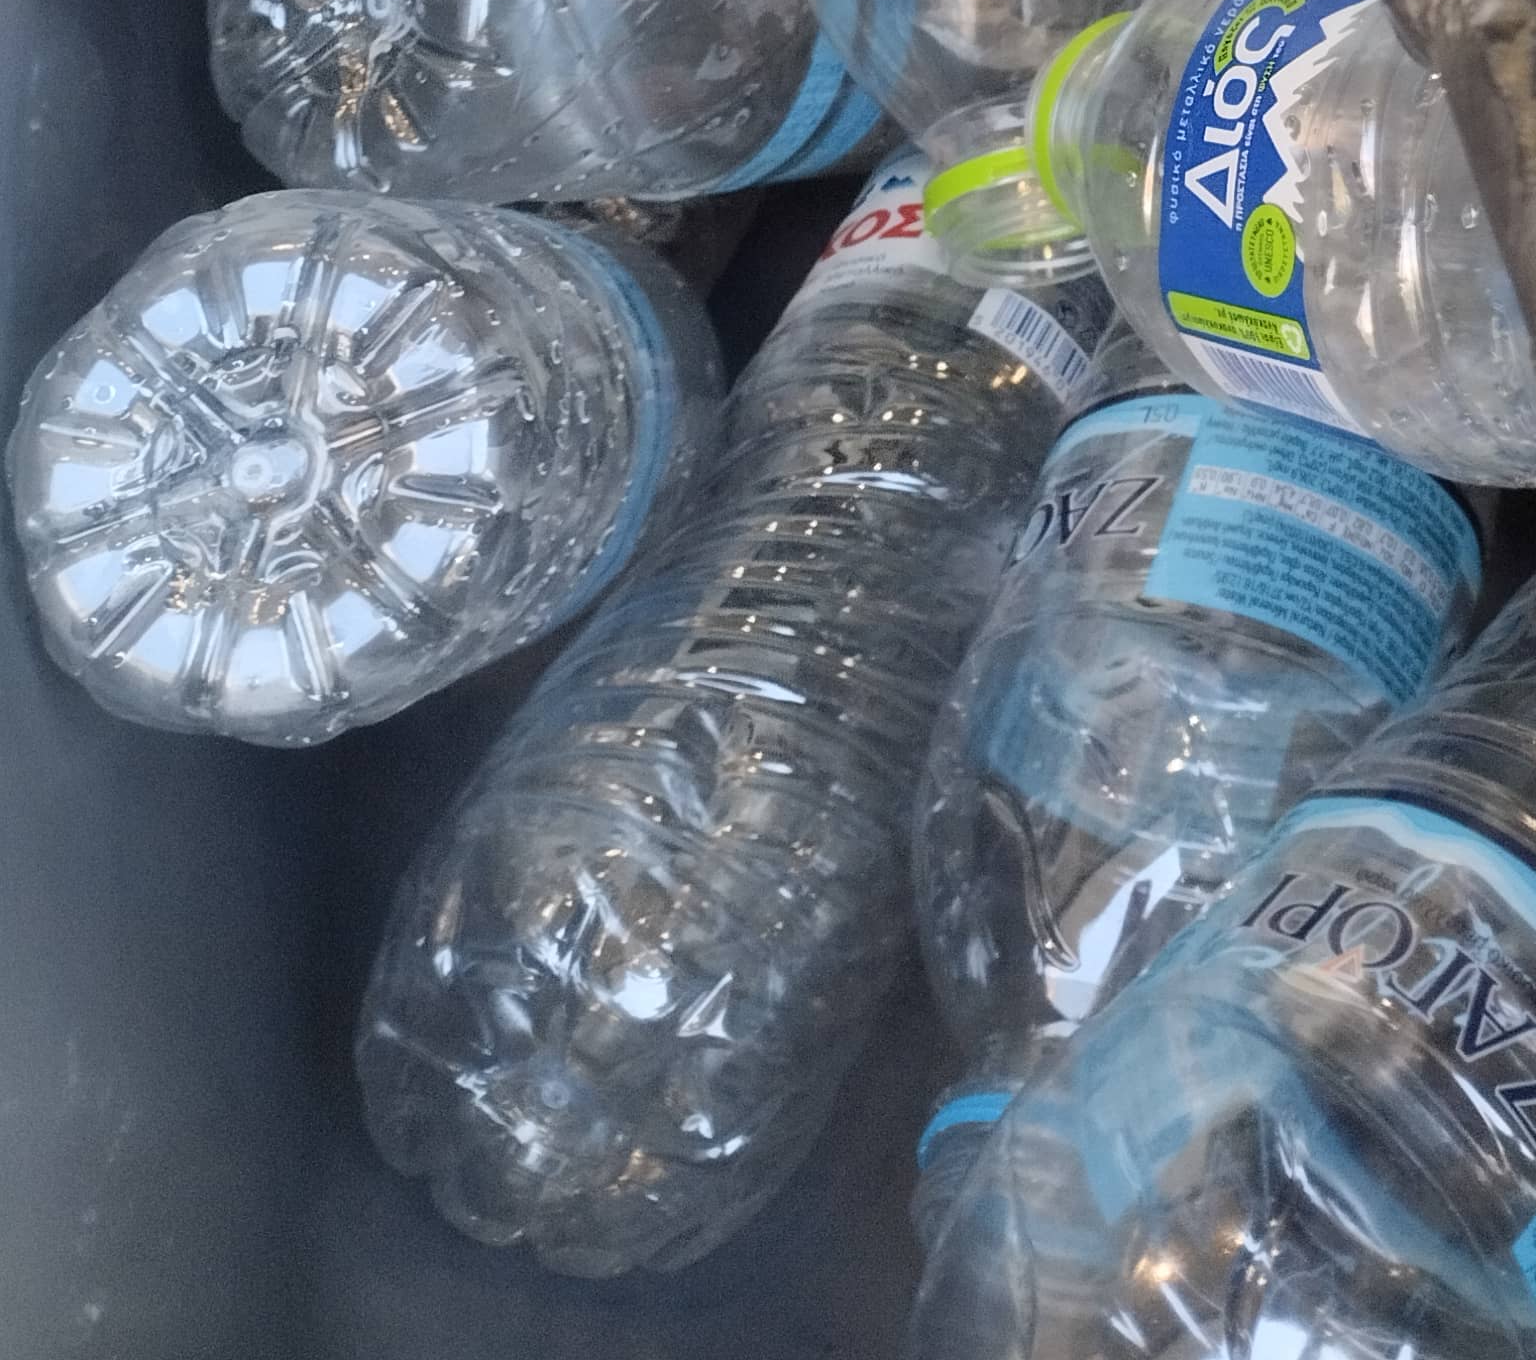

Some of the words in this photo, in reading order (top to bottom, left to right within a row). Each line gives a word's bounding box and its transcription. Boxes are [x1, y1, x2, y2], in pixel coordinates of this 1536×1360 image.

[1169, 150, 1183, 224] φυσικό
[1176, 44, 1216, 141] μεταλλικό
[1184, 15, 1297, 229] Διός
[1235, 149, 1250, 221] ΠΡΟΣΤΑΣΙΑ
[1264, 229, 1275, 273] UNESCO
